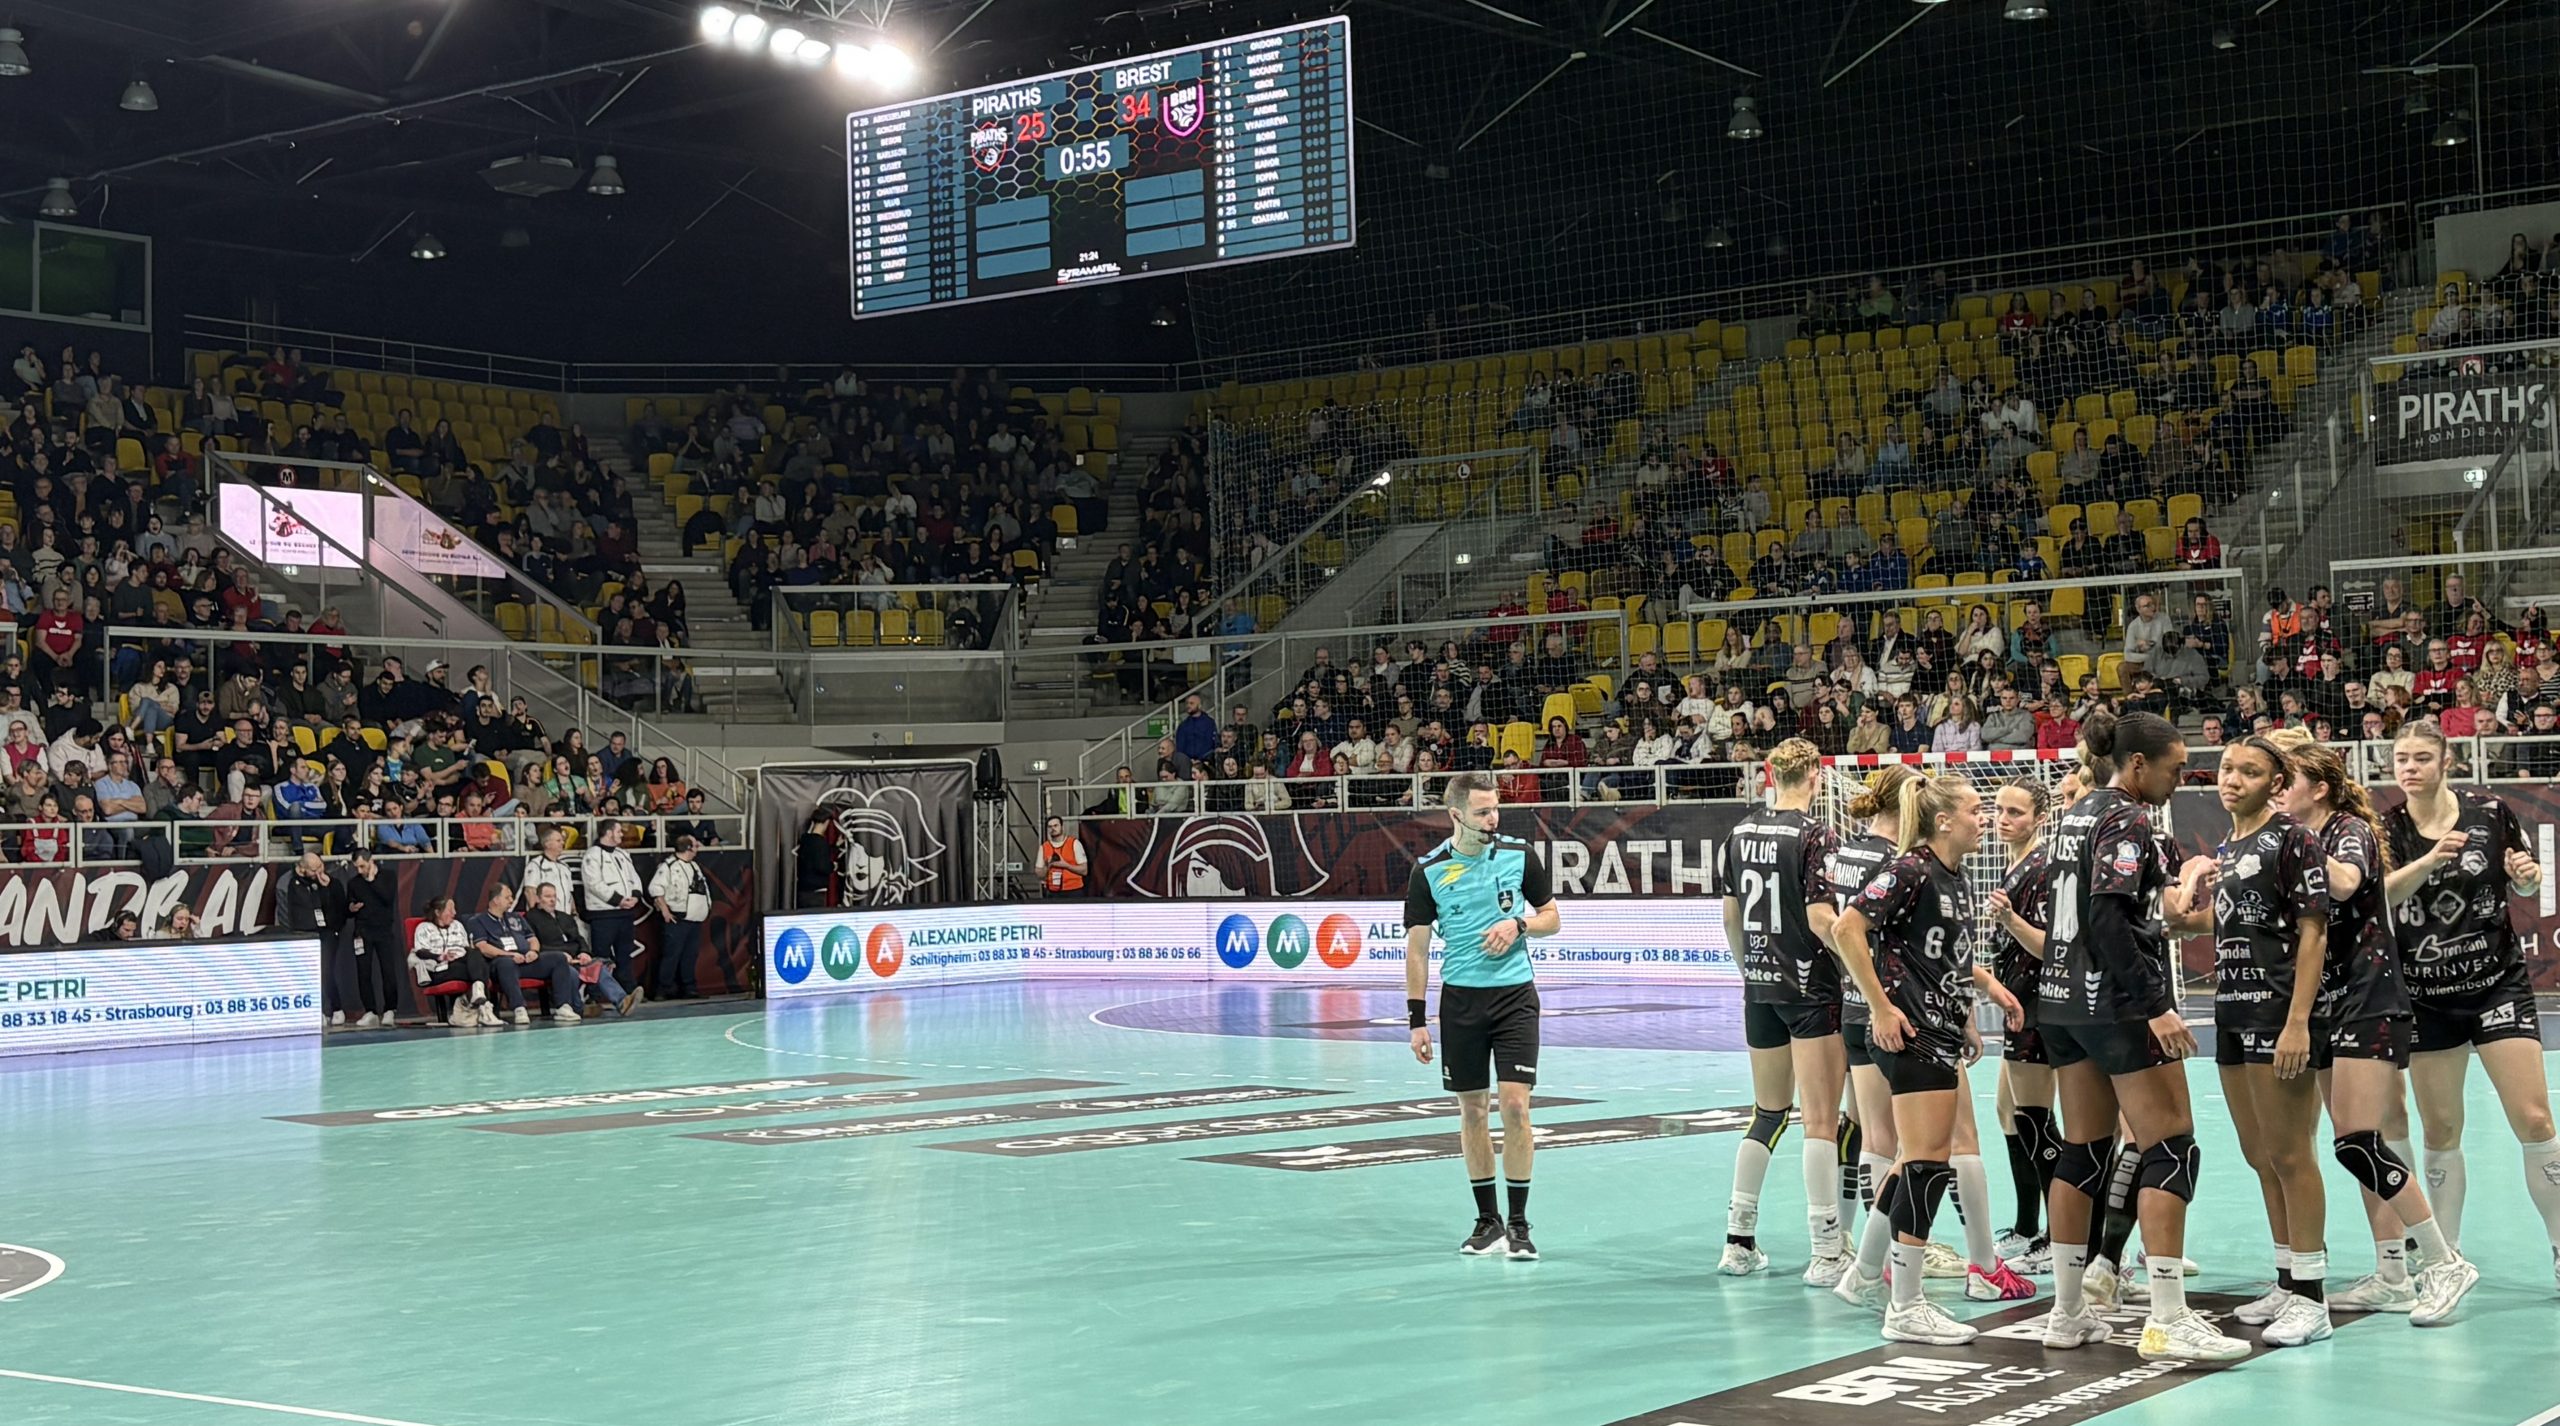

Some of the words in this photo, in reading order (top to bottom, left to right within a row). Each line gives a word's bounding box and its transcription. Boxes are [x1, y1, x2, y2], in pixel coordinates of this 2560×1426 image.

[1116, 61, 1172, 89] BREST
[1225, 73, 1230, 82] 2
[972, 87, 1042, 116] PIRATHS
[1122, 91, 1151, 124] 34
[1170, 87, 1196, 106] BBH
[971, 127, 1008, 147] PIRATHS
[1016, 111, 1047, 142] 25
[1060, 140, 1111, 174] 0:55
[1225, 167, 1234, 176] 21
[1079, 251, 1099, 262] 21:24
[1058, 263, 1121, 281] STRAMATEL
[2399, 384, 2550, 440] PIRATHS
[1740, 839, 1778, 864] VLUG
[1740, 869, 1782, 934] 21
[909, 927, 997, 946] ALEXANDRE
[1001, 923, 1043, 941] PETRI
[1225, 930, 1250, 953] M
[1276, 930, 1301, 953] M
[1328, 929, 1349, 954] A
[1924, 926, 1945, 960] 6
[783, 945, 806, 968] M
[830, 943, 853, 965] M
[877, 940, 893, 962] A
[910, 950, 972, 967] Schiltigheim
[978, 950, 990, 962] 03
[993, 949, 1005, 962] 88
[1007, 949, 1019, 961] 33
[1021, 948, 1031, 960] 18
[1033, 948, 1047, 959] 45
[1055, 947, 1114, 962] Strasbourg
[1122, 948, 1136, 959] 03
[1139, 948, 1153, 959] 88
[1155, 948, 1169, 959] 36
[1172, 948, 1186, 959] 05
[1188, 948, 1201, 959] 66
[1531, 948, 1547, 961] 45
[1558, 947, 1631, 964] Strasbourg
[1642, 949, 1659, 961] 03
[1663, 949, 1680, 961] 88
[1683, 949, 1699, 961] 36
[1703, 949, 1720, 961] 05
[17, 978, 87, 1000] PETRI
[26, 1012, 47, 1026] 33
[51, 1011, 67, 1025] 18
[71, 1009, 92, 1023] 45
[105, 1003, 193, 1021] Strasbourg
[205, 1001, 223, 1015] 03
[227, 999, 246, 1013] 88
[250, 998, 268, 1011] 36
[271, 996, 290, 1009] 05
[294, 995, 312, 1008] 66
[644, 1091, 920, 1118] OKKO
[995, 1099, 1500, 1149] agoracalyc
[1773, 1356, 1992, 1407] BFM
[1897, 1365, 2065, 1413] ALSACE
[2050, 1376, 2137, 1409] VOTRE
